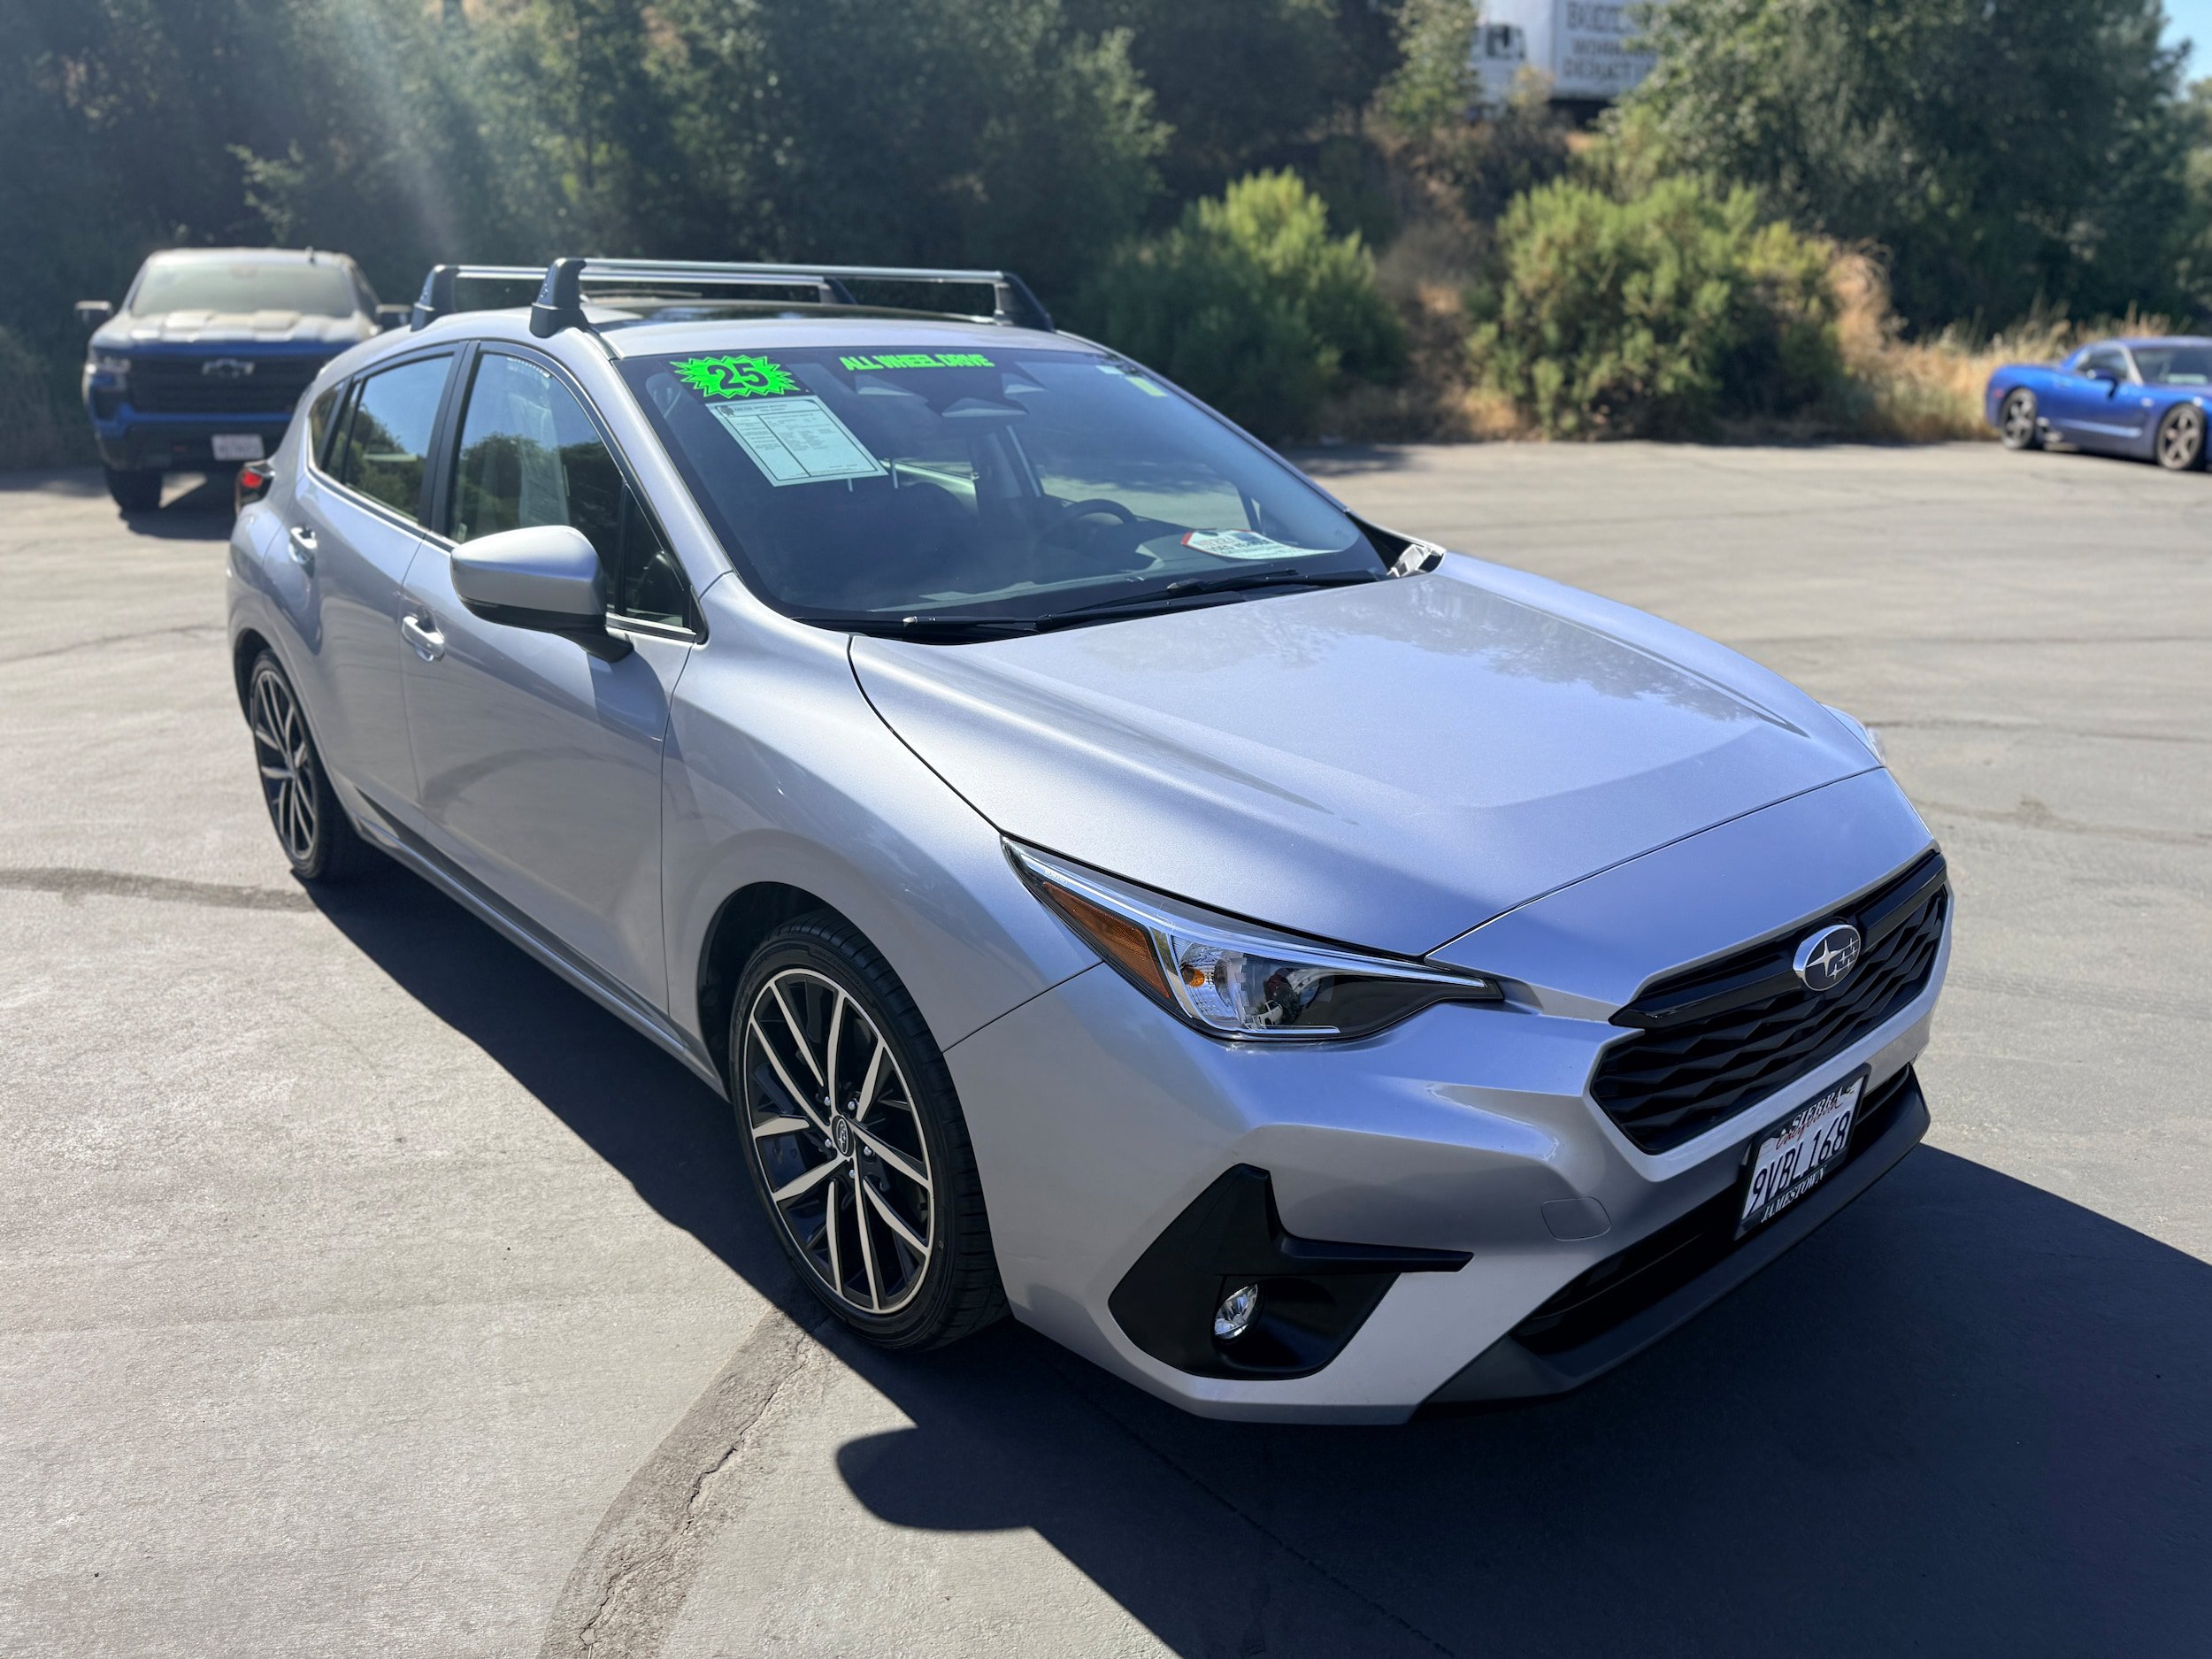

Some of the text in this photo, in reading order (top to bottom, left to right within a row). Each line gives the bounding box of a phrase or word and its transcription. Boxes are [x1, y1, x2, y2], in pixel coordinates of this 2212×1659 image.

[840, 354, 995, 371] ALL WHEEL DRIVE
[707, 363, 770, 390] 25
[1792, 1086, 1844, 1128] SIERRA
